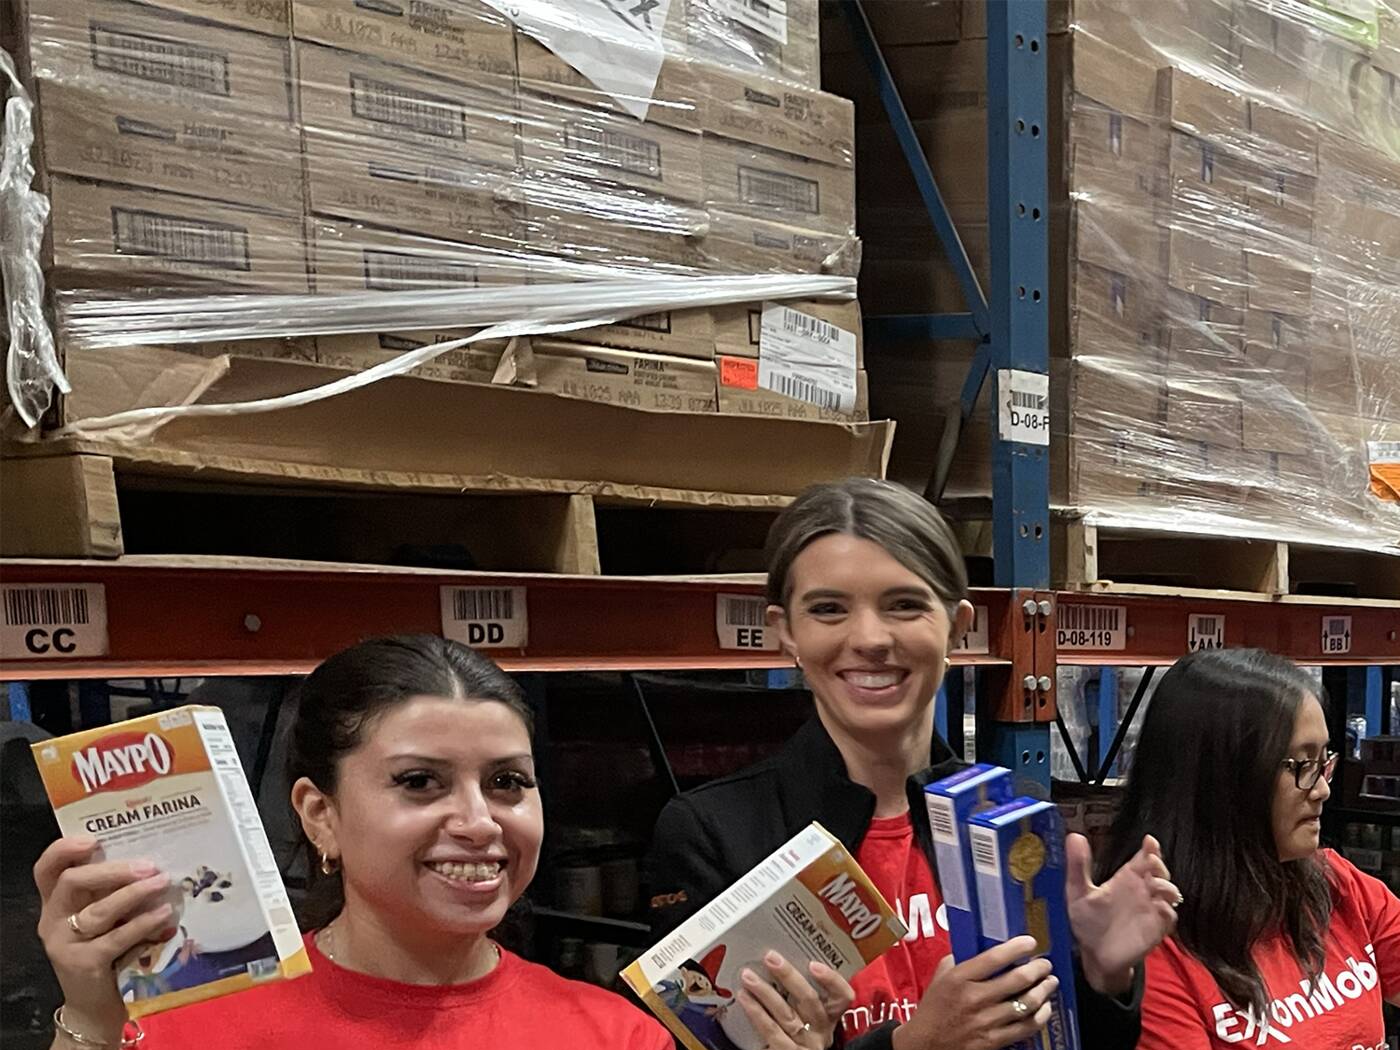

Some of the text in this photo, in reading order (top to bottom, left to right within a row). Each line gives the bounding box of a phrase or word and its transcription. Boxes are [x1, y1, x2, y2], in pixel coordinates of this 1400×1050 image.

[25, 628, 76, 654] CC
[468, 623, 504, 644] DD
[736, 629, 763, 648] EE
[1057, 630, 1112, 647] D-08-119
[1329, 638, 1343, 651] BB
[72, 732, 171, 793] MAYPO
[86, 807, 141, 833] CREAM
[143, 794, 201, 820] FARINA
[818, 872, 882, 940] MAYPO
[785, 900, 844, 970] CREAM FARINA
[1212, 943, 1378, 1046] ExxonMobi
